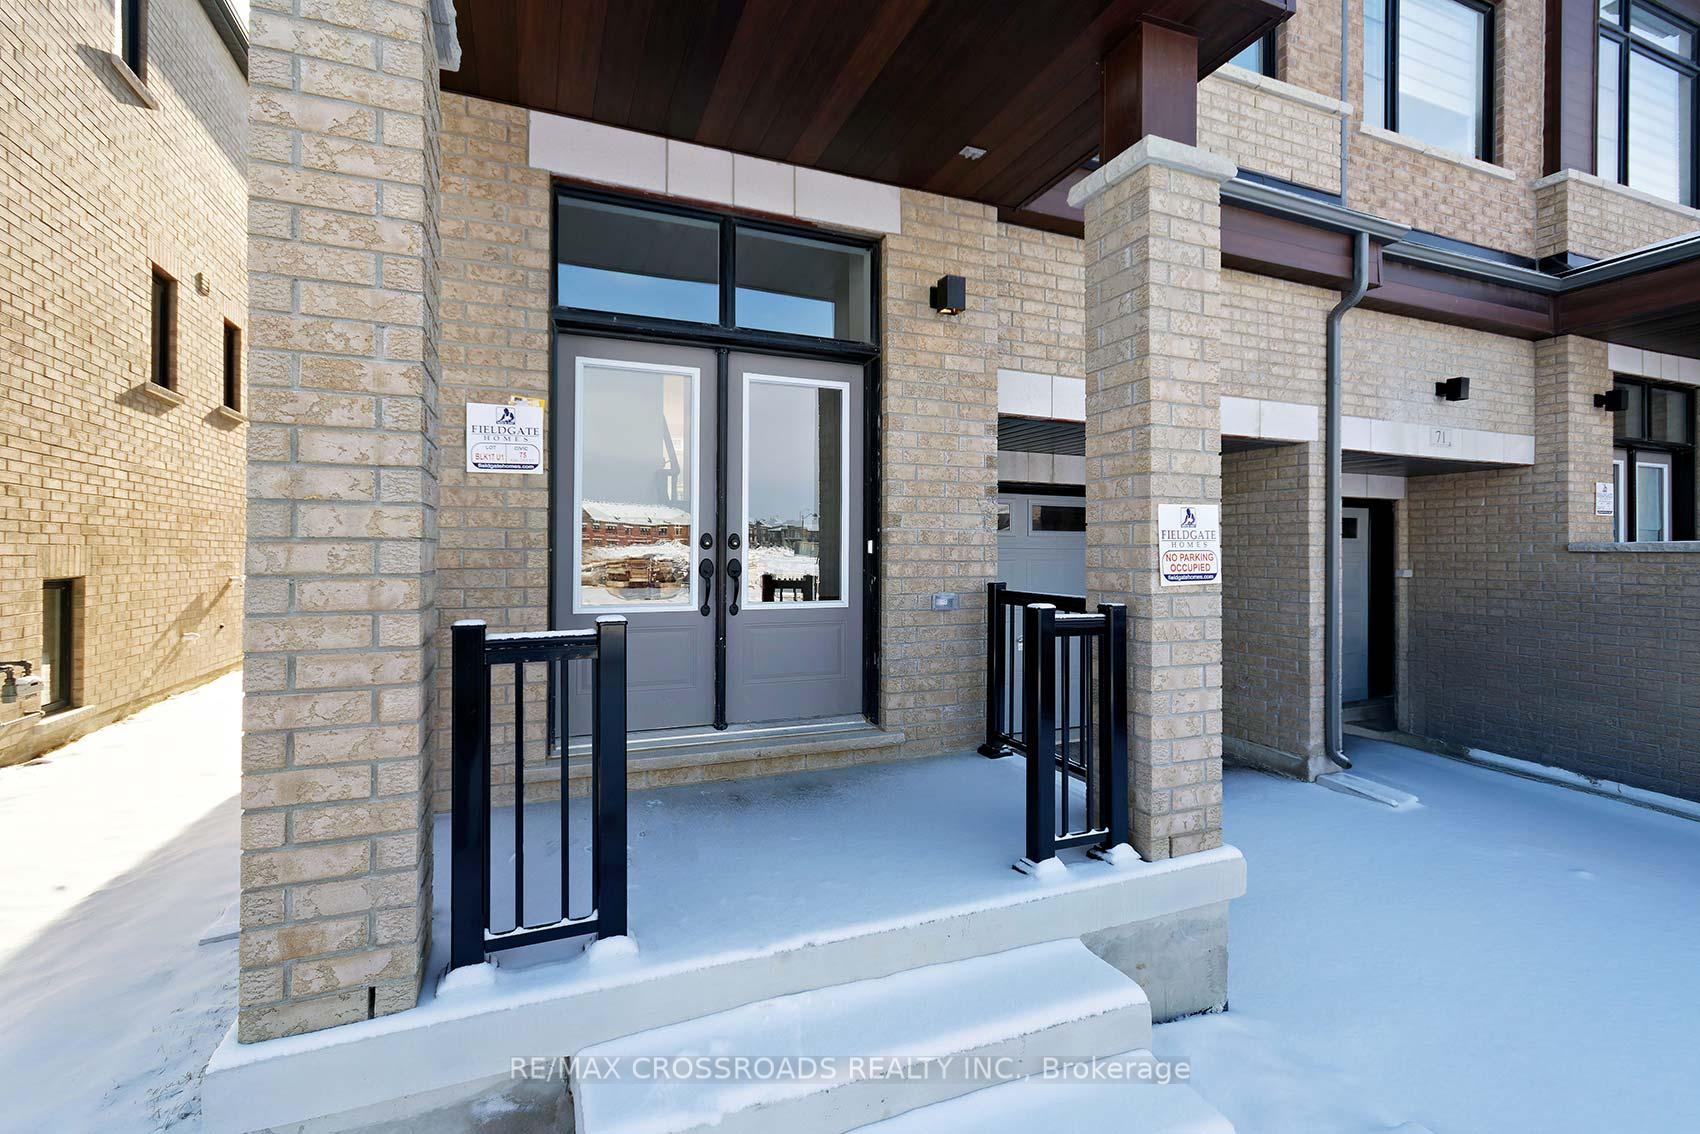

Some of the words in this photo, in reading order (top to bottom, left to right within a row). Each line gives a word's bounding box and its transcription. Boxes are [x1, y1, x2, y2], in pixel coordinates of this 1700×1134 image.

[471, 425, 540, 436] FIELDGATE
[483, 435, 529, 443] HOMES
[1435, 430, 1446, 444] 71
[1161, 530, 1217, 540] FIELDGATE
[1165, 553, 1178, 562] NO
[1179, 553, 1214, 562] PARKING
[1170, 563, 1211, 572] OCCUPIED
